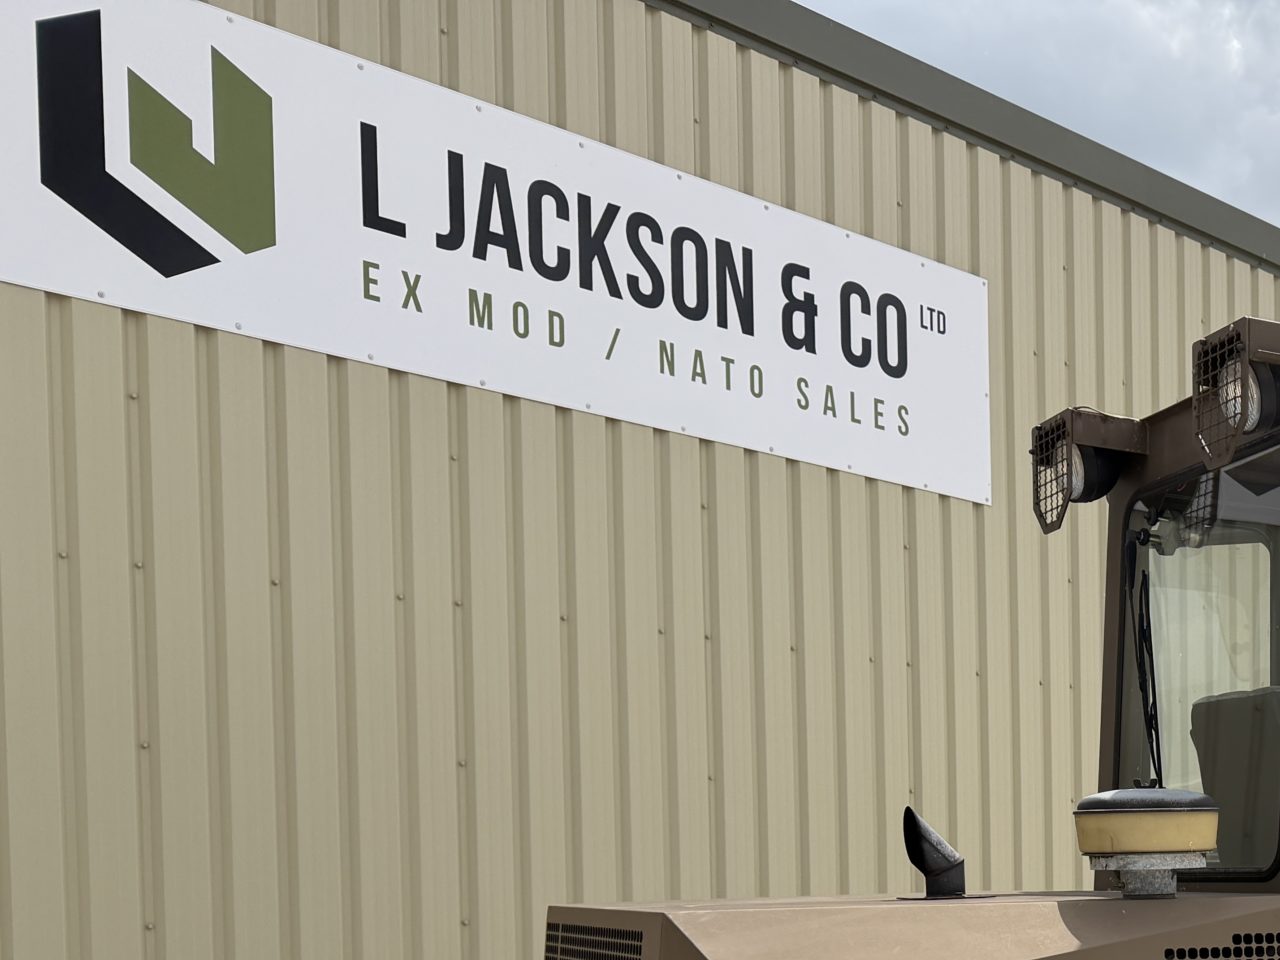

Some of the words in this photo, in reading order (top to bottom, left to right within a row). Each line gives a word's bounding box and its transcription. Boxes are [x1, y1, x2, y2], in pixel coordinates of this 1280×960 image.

[360, 121, 406, 238] L
[436, 150, 755, 337] JACKSON
[781, 262, 818, 354] &
[840, 281, 908, 379] CO
[920, 304, 946, 335] LTD
[363, 260, 423, 313] EX
[468, 288, 565, 348] MOD
[605, 328, 621, 360] /
[659, 339, 764, 398] NATO
[796, 377, 910, 436] SALES
